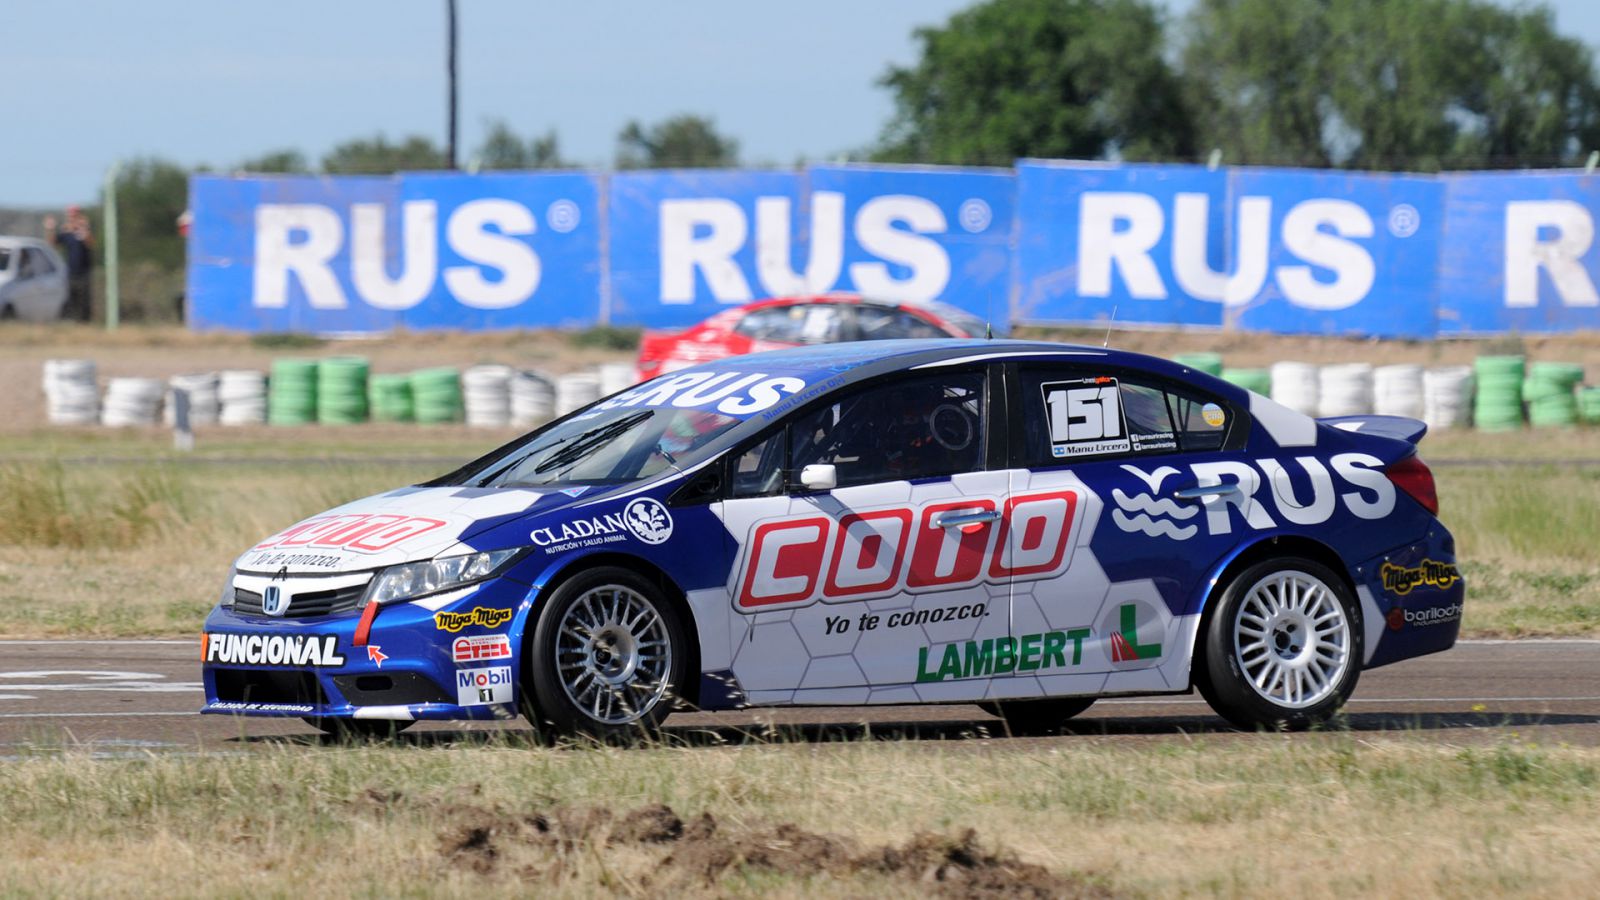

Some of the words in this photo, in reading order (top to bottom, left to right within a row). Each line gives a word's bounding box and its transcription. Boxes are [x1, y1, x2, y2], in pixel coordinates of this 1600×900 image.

[253, 198, 542, 310] RUS
[658, 191, 951, 303] RUS
[1077, 191, 1376, 310] RUS
[1505, 200, 1600, 307] R
[621, 372, 805, 415] RUS
[1047, 386, 1120, 442] 151
[1066, 444, 1094, 454] Manu
[1096, 442, 1129, 453] Urcera
[1190, 453, 1396, 536] RUS
[530, 512, 627, 546] CLADAN
[578, 540, 583, 548] Y
[583, 537, 603, 548] SALUD
[604, 534, 627, 543] ANIMAL
[740, 490, 1078, 608] COTO
[825, 615, 850, 635] Yo
[858, 612, 880, 632] te
[887, 602, 990, 628] conozco.
[208, 634, 344, 665] FUNCIONAL
[915, 628, 1091, 683] LAMBERT
[459, 668, 511, 688] Mobil
[482, 689, 490, 702] 1
